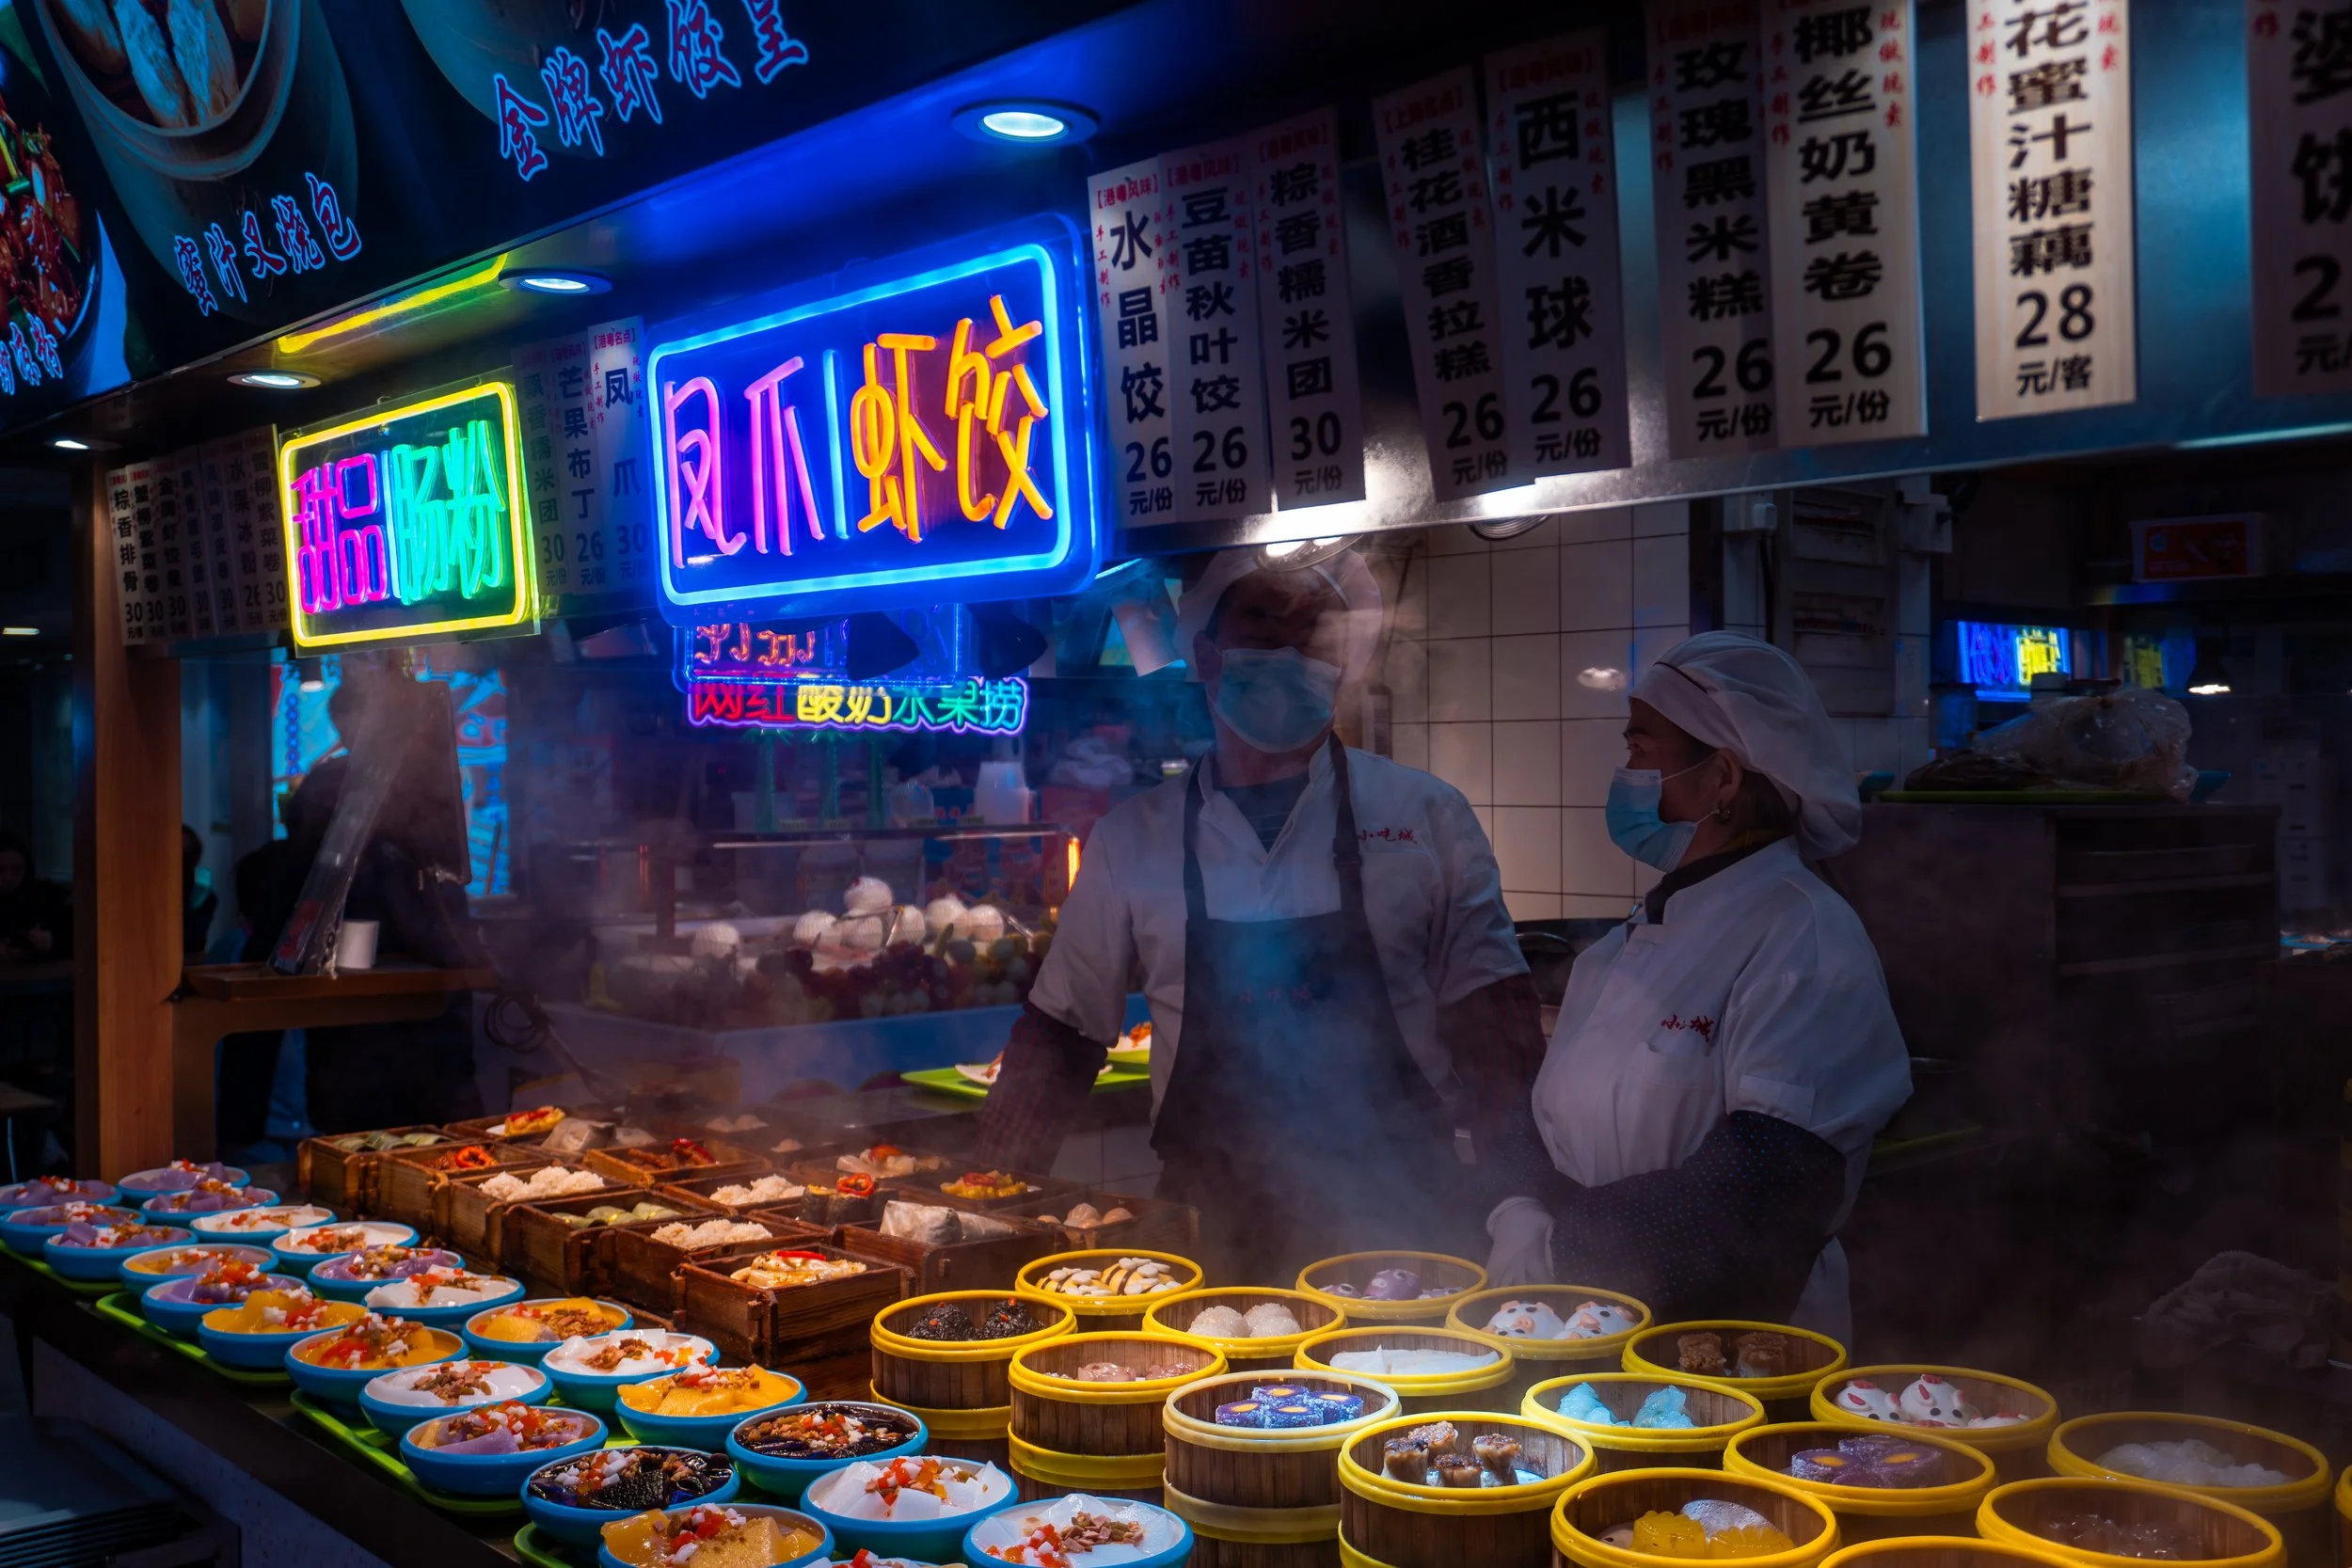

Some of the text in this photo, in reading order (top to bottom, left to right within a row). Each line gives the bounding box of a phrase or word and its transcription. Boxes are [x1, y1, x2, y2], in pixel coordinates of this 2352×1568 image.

[1793, 6, 1883, 302] 椰丝奶黄卷
[2004, 0, 2095, 277] 花蜜汁糖藕
[1675, 41, 1765, 322] 玫瑰黑米糕
[1514, 90, 1594, 350] 西米球
[1401, 127, 1492, 382] 桂花酒香拉糕
[1182, 187, 1241, 414] 豆苗秋叶饺
[1271, 163, 1333, 400] 粽香糯米团
[1109, 211, 1166, 423] 水晶饺
[2015, 283, 2095, 350] 28
[1692, 338, 1773, 400] 26
[1805, 322, 1892, 385] 26
[2017, 353, 2094, 397] 元/客
[1442, 392, 1504, 450] 26
[1531, 368, 1602, 424] 26
[1809, 389, 1890, 428] 元/份
[559, 366, 595, 519] 芒果布丁
[605, 368, 642, 498] 凤爪
[663, 294, 1054, 569] 凤爪 虾饺
[1291, 411, 1341, 461] 30
[1535, 427, 1601, 464] 元/份
[1698, 404, 1773, 442] 元/份
[1125, 436, 1172, 483] 26
[1193, 426, 1248, 473] 26
[1452, 449, 1508, 485] 元/份
[1130, 486, 1173, 515] 元/份
[1197, 478, 1247, 507] 元/份
[1295, 465, 1343, 496] 元/份
[291, 452, 389, 614] 甜品
[542, 533, 564, 563] 30
[576, 531, 604, 562] 26
[616, 523, 647, 555] 30
[125, 602, 143, 623] 30
[147, 600, 164, 622] 30
[167, 595, 186, 617] 30
[694, 679, 1023, 729] 网红酸奶水果捞
